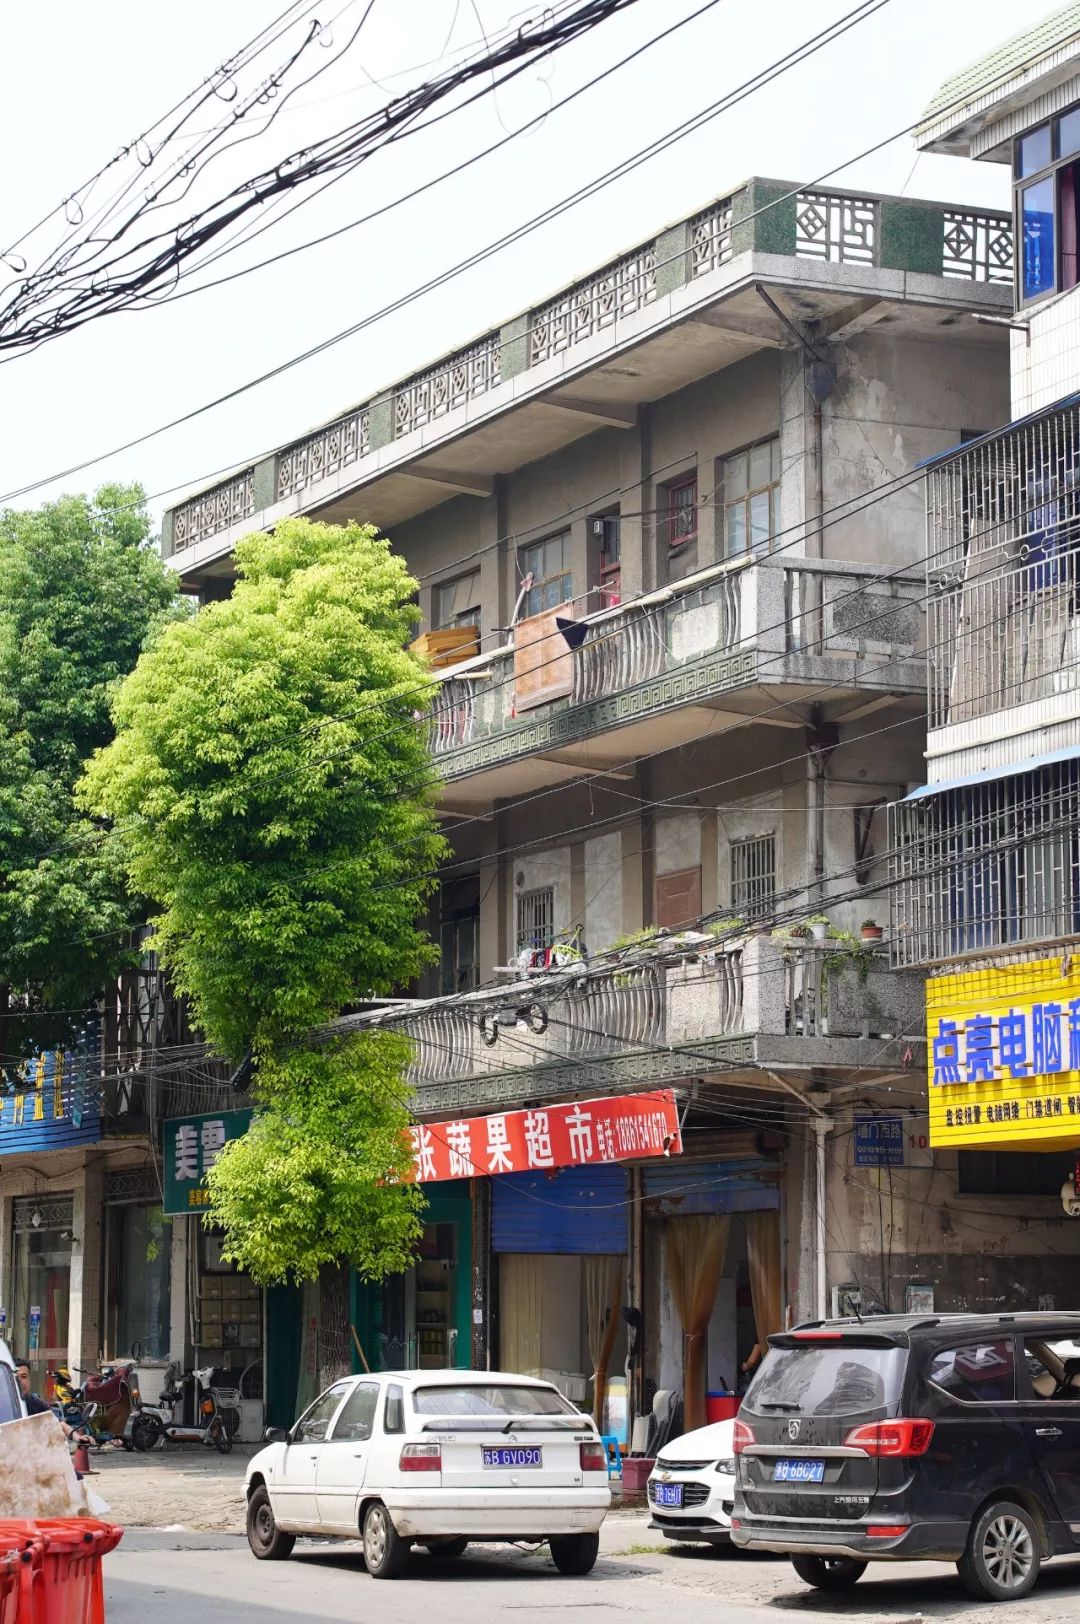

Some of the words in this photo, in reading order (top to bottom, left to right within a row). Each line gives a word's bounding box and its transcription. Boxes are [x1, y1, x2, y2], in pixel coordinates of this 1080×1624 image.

[946, 1105, 981, 1127] 监控报警
[986, 1101, 1019, 1123] 电脑网络
[503, 1450, 541, 1465] GV090
